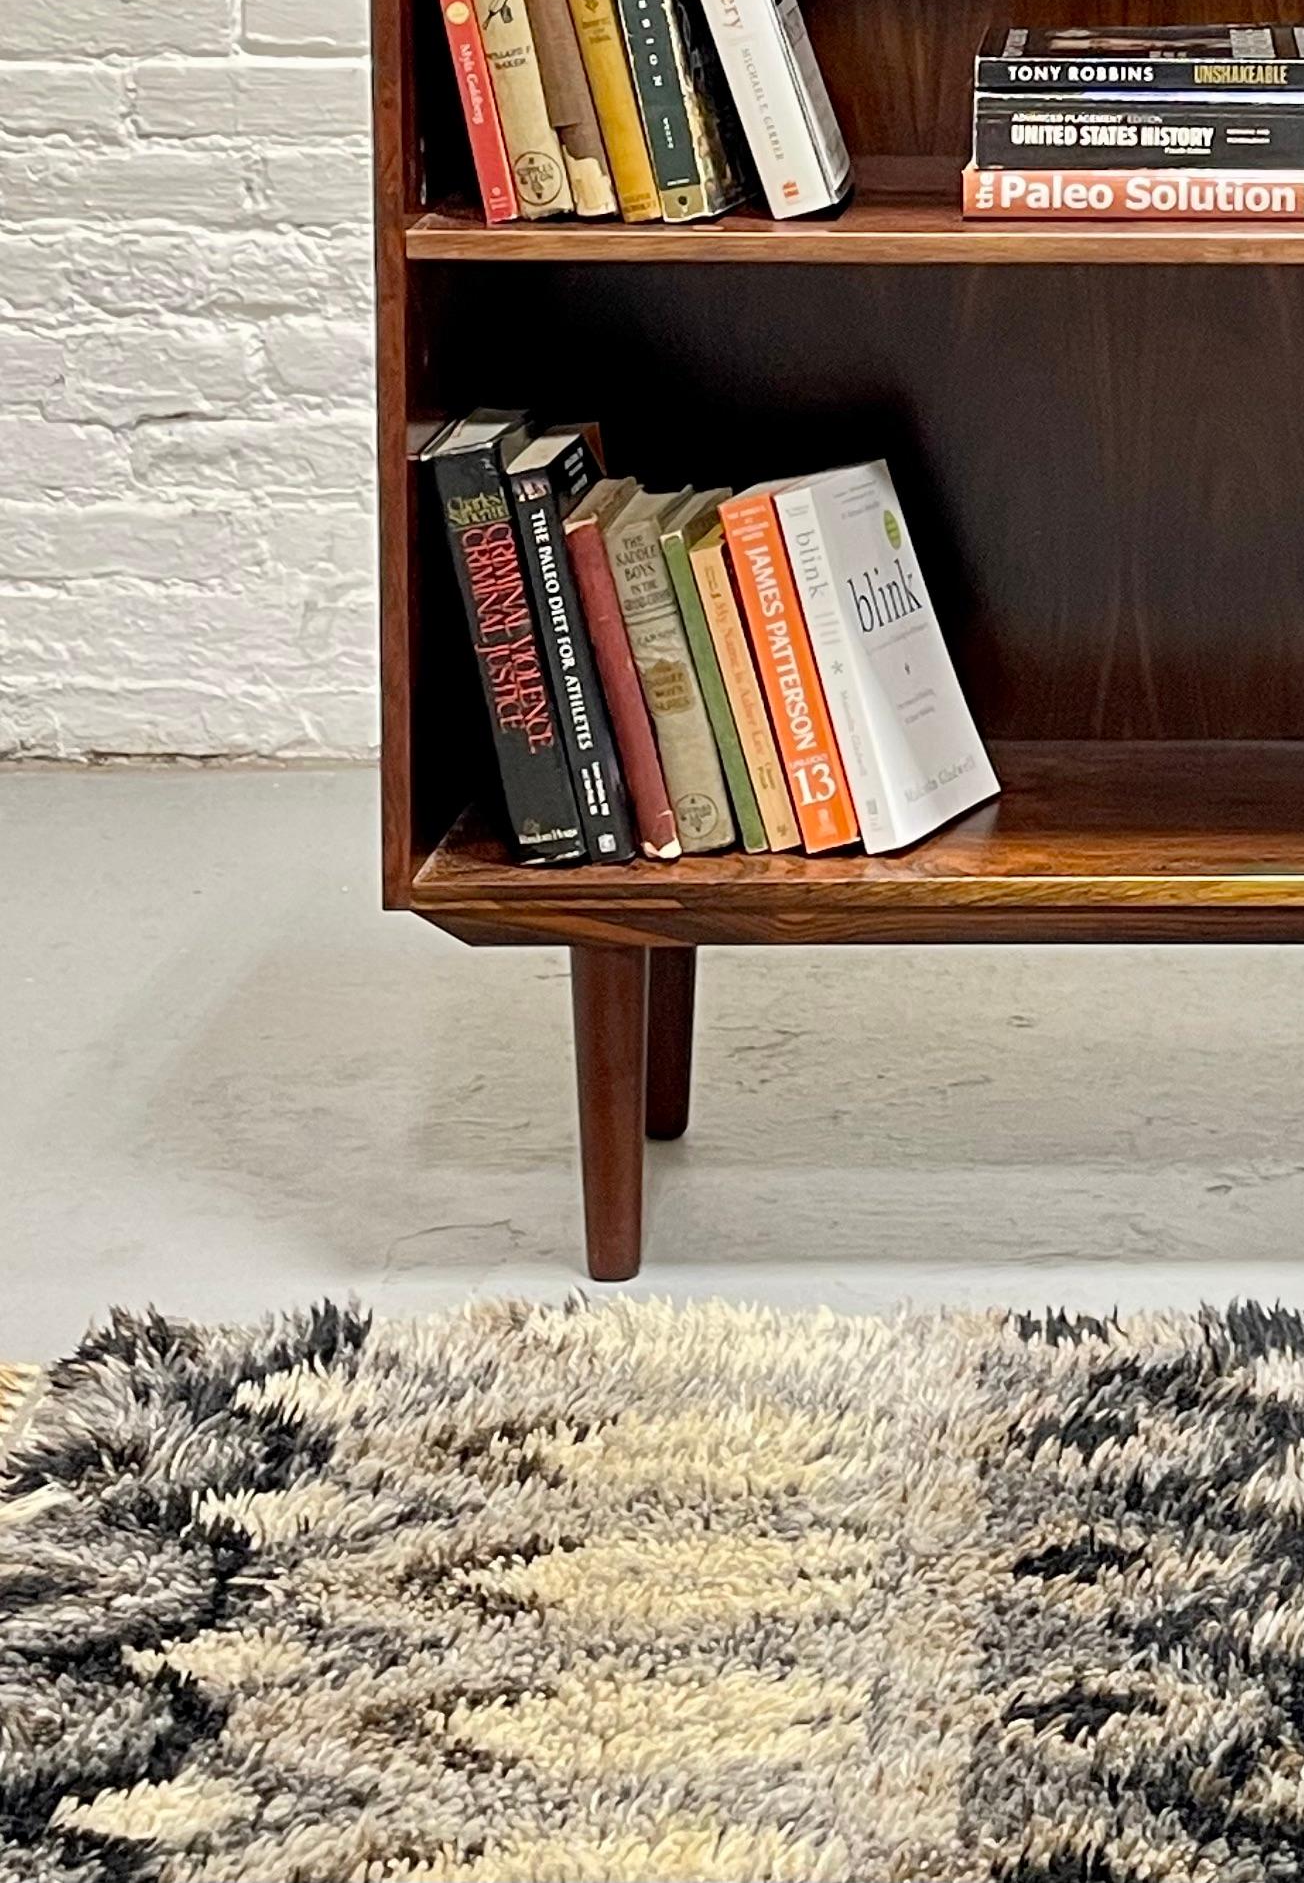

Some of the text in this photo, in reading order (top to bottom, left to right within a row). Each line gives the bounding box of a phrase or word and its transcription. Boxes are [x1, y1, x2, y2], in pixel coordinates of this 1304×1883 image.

[1008, 66, 1155, 82] TONY ROBBINS
[1194, 65, 1288, 84] UNSHAKEABLE
[1011, 125, 1077, 145] UNITED
[1079, 126, 1138, 146] STATES
[1140, 126, 1214, 147] HISTORY
[975, 172, 1295, 212] the Paleo Solution
[459, 527, 508, 643] CRIMINAL
[481, 521, 533, 637] CRIMINAL
[624, 563, 655, 581] BOYS
[794, 529, 830, 600] blink
[847, 559, 923, 633] blink
[529, 509, 594, 750] THE PALEO DIET FOR ATHLETES
[743, 545, 784, 618] JAMES
[764, 619, 817, 750] PATTERSON
[473, 637, 527, 736] JUSTICE
[791, 762, 838, 806] 13
